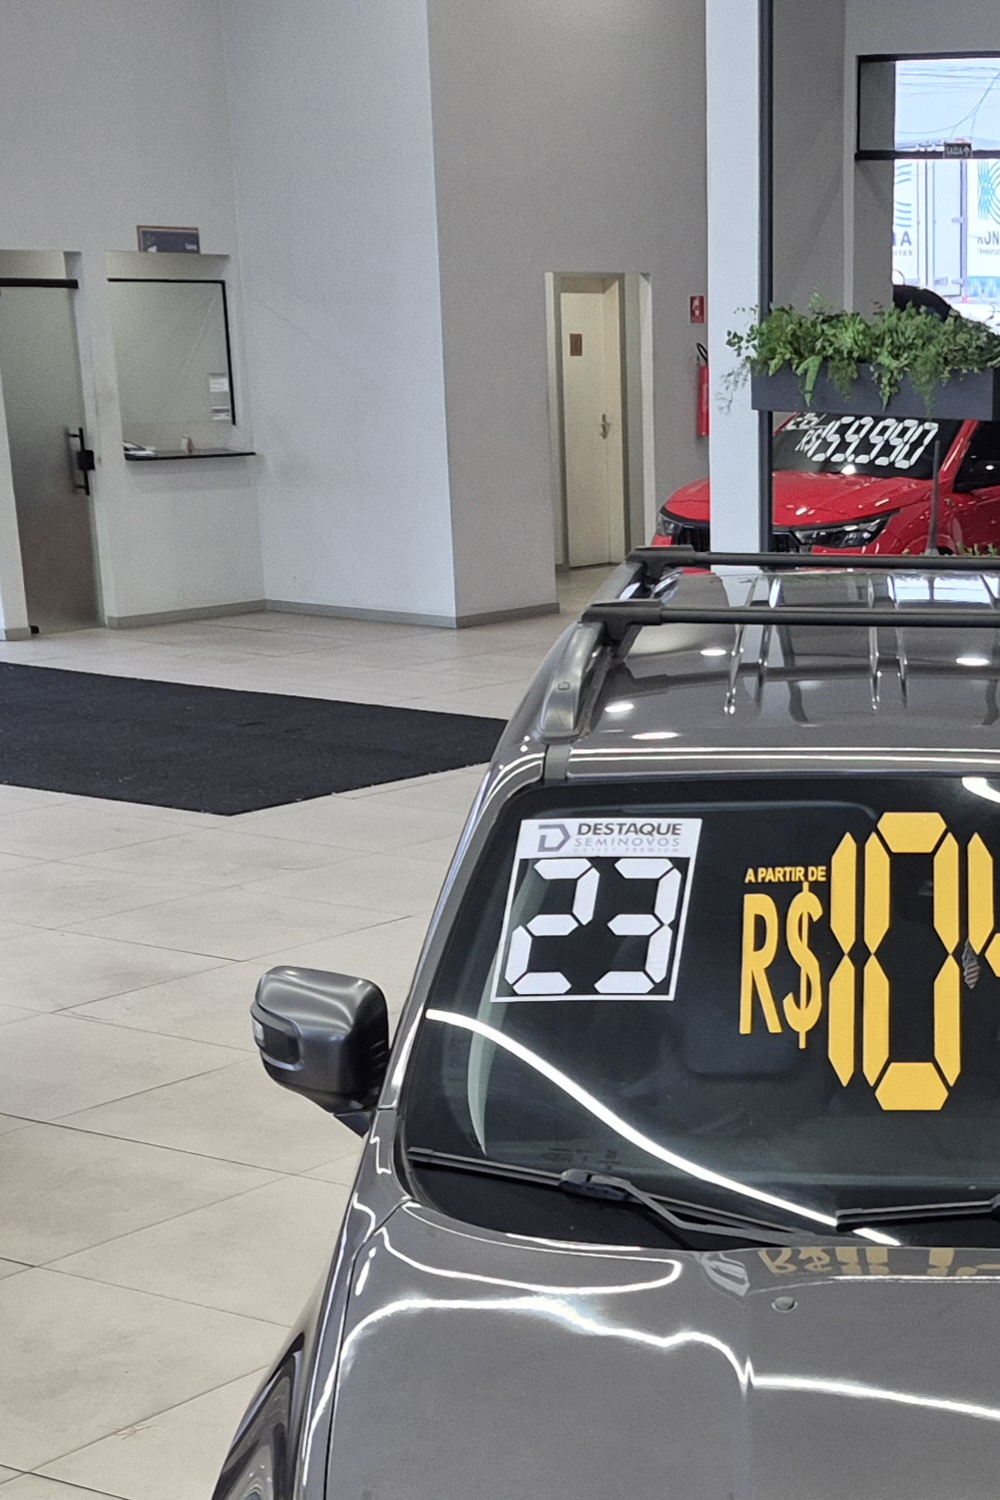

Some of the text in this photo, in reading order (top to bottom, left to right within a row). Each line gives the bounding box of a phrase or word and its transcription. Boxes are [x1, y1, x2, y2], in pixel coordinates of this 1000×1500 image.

[577, 823, 682, 836] DESTAQUE
[574, 837, 680, 847] SEMINOVOS
[745, 866, 827, 883] A PARTIR DE
[504, 858, 683, 995] 23
